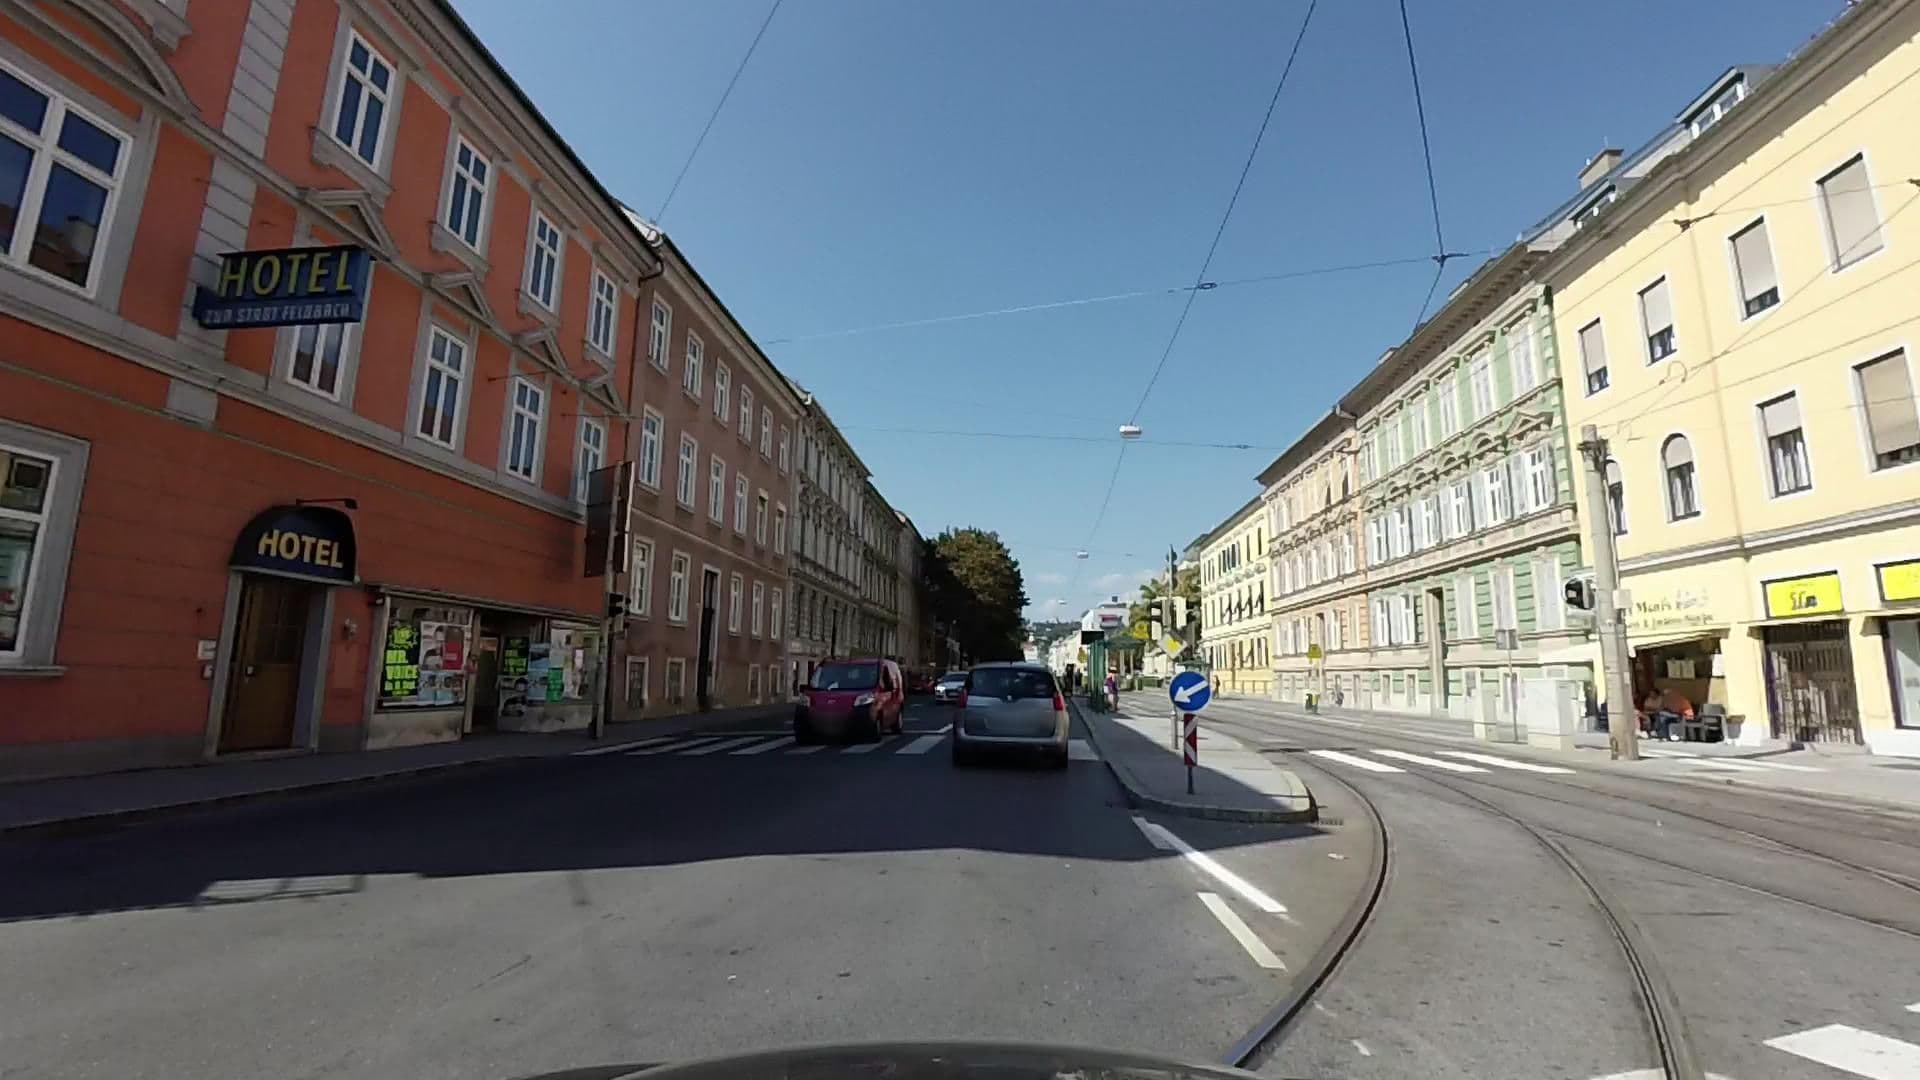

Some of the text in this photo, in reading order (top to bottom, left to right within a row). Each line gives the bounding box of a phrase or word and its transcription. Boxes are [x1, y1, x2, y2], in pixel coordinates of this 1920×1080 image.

[218, 251, 353, 297] HOTEL
[281, 303, 350, 320] FELDBACH
[258, 529, 343, 568] HOTEL
